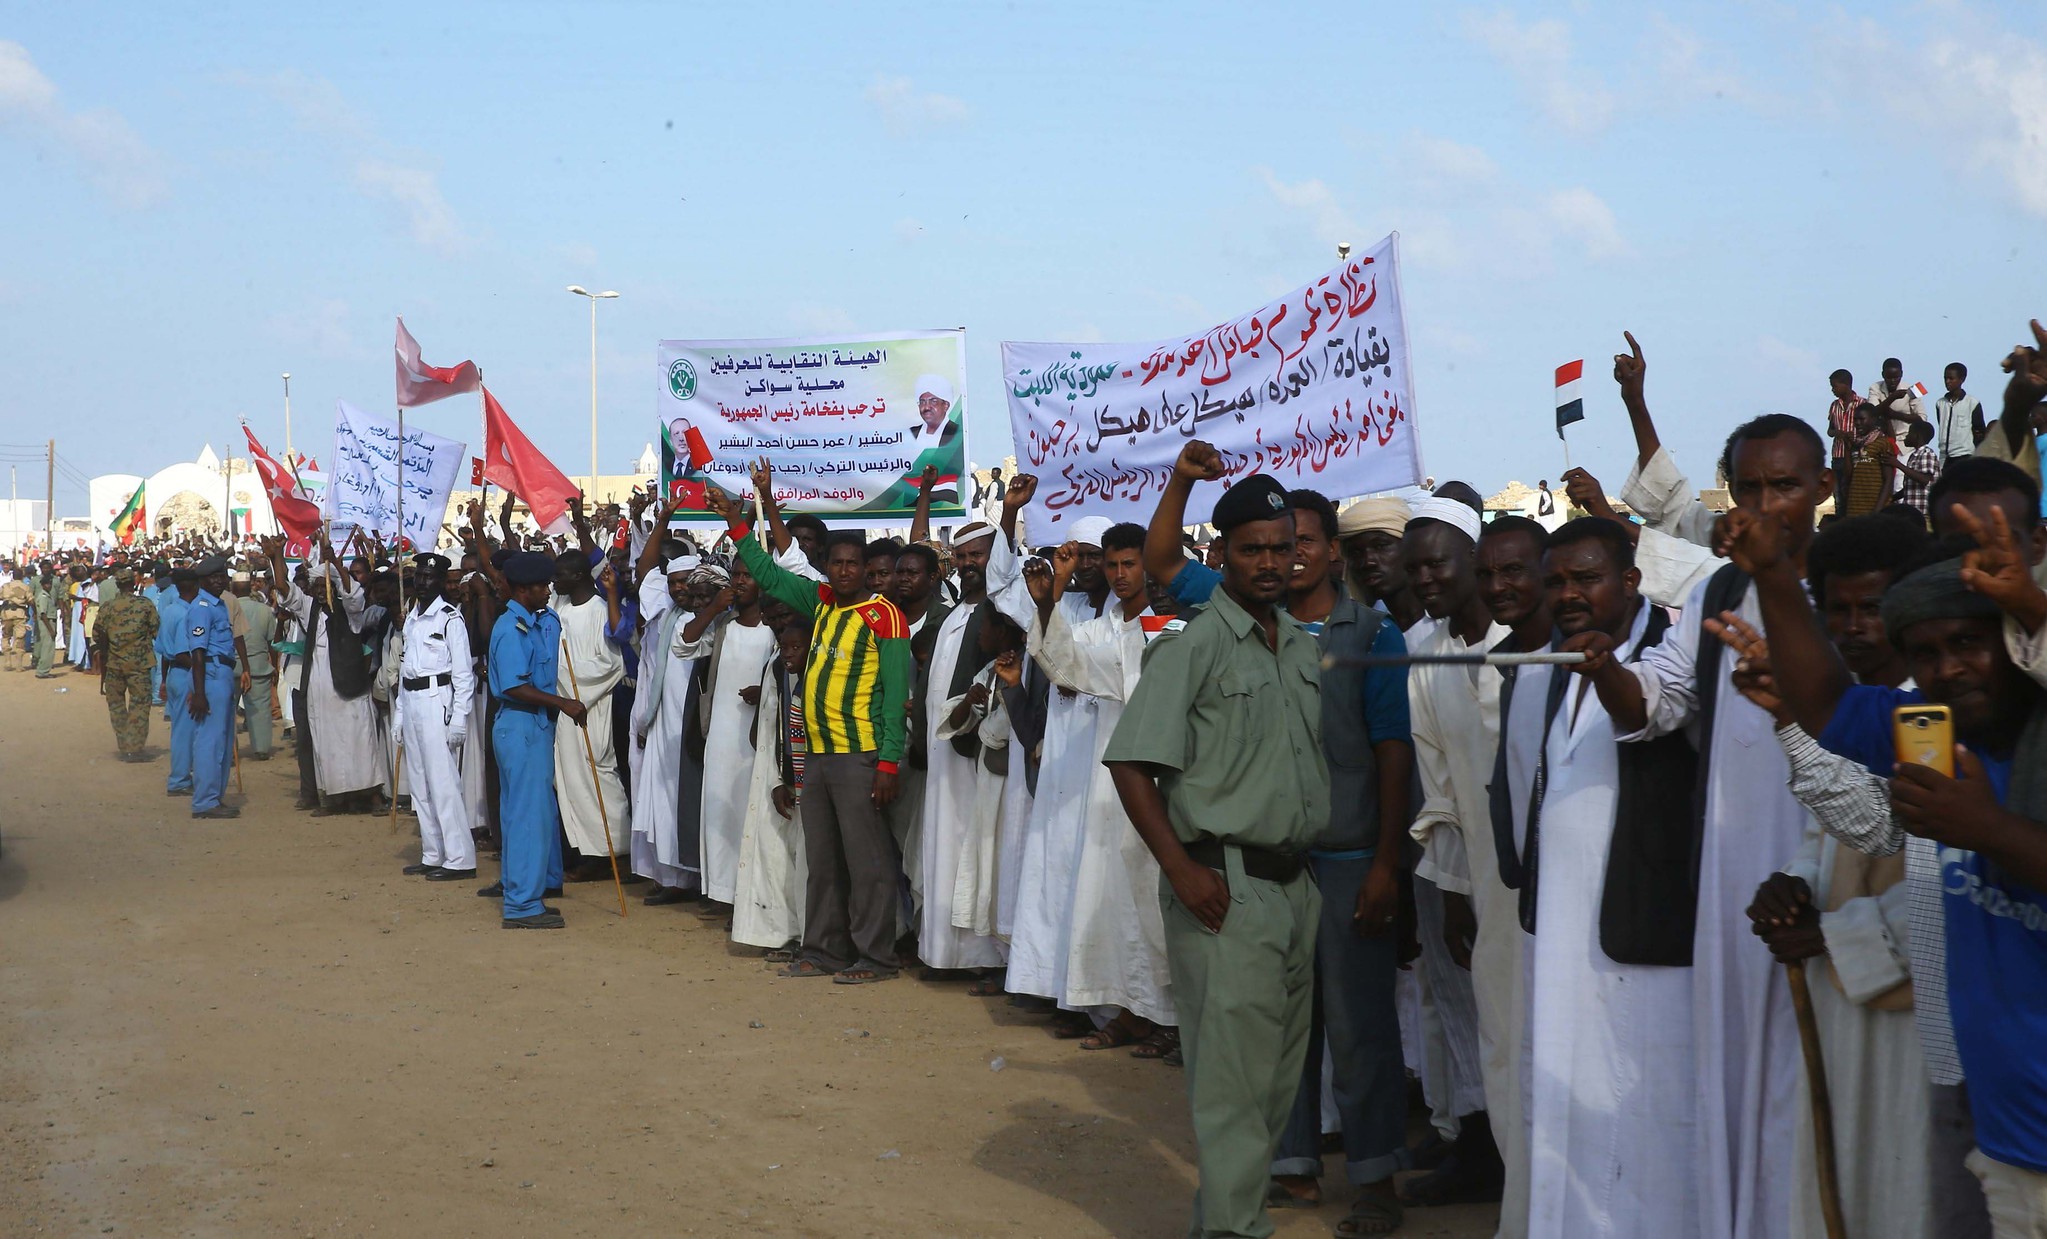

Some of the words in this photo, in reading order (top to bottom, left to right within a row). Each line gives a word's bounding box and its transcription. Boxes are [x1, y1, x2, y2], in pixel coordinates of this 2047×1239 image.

[710, 354, 762, 375] للحرفيين
[765, 352, 828, 374] النقابية
[832, 349, 887, 370] الهيئة
[745, 378, 792, 396] سواكن
[796, 376, 845, 395] محلية
[717, 402, 768, 423] الجمهورية
[770, 402, 799, 422] رئيس
[801, 401, 844, 421] بفخامة
[847, 398, 886, 418] ترحب
[718, 435, 753, 449] البشير
[756, 435, 783, 448] أحمد
[785, 438, 818, 449] حسن
[822, 438, 845, 449] عمر
[857, 431, 903, 447] المشير
[778, 462, 806, 475] رجب
[858, 457, 912, 474] والرئيس
[773, 487, 820, 501] المرافق
[822, 488, 865, 501] والوفد
